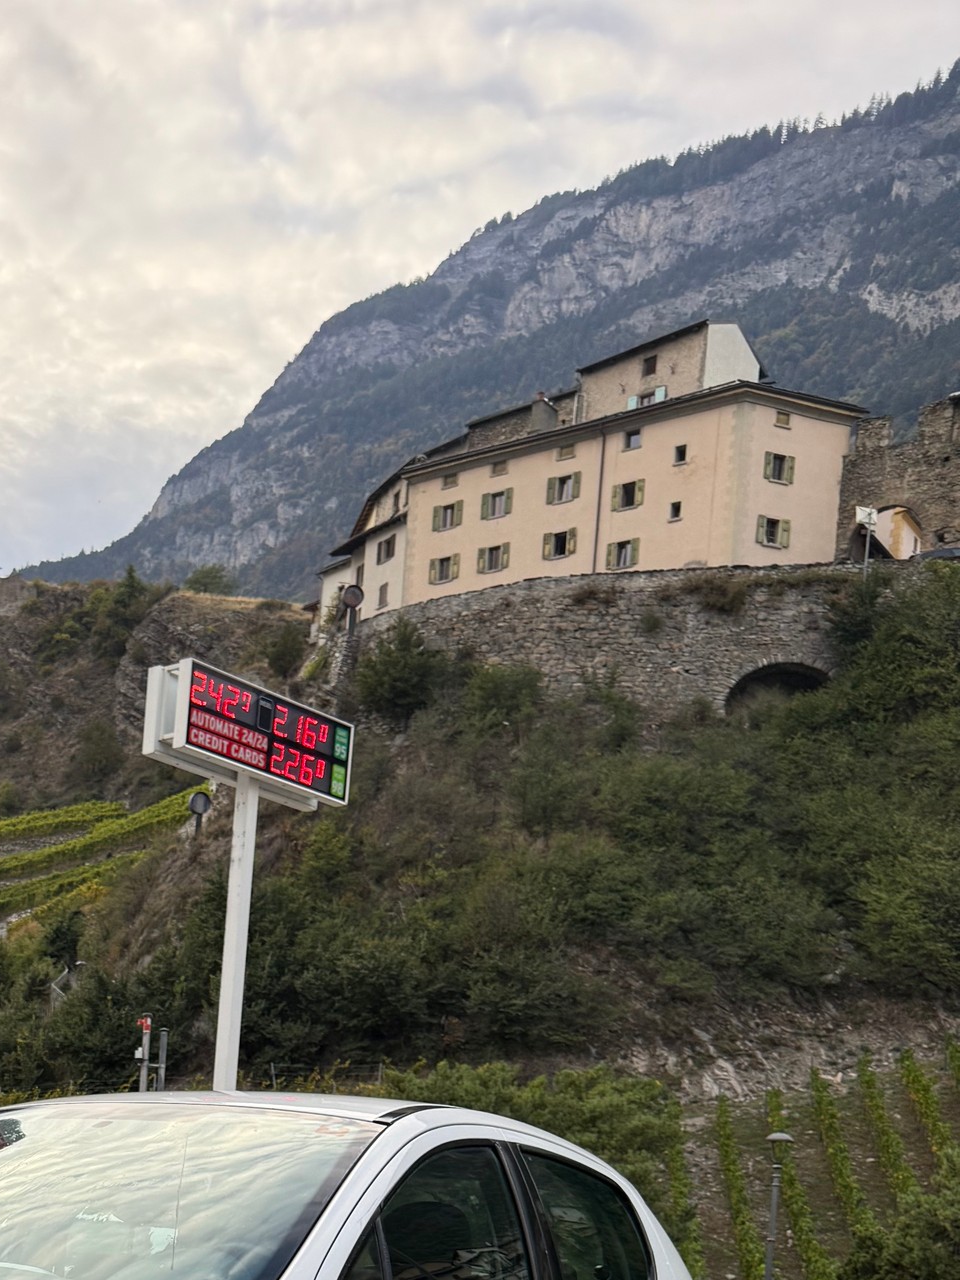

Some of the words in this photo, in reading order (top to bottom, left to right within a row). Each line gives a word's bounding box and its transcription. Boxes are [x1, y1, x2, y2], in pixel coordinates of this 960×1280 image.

[190, 709, 240, 740] AUTOMATE
[241, 729, 268, 751] 24/24
[190, 729, 229, 754] CREDIT
[230, 744, 265, 767] CARDS
[334, 744, 347, 759] 95
